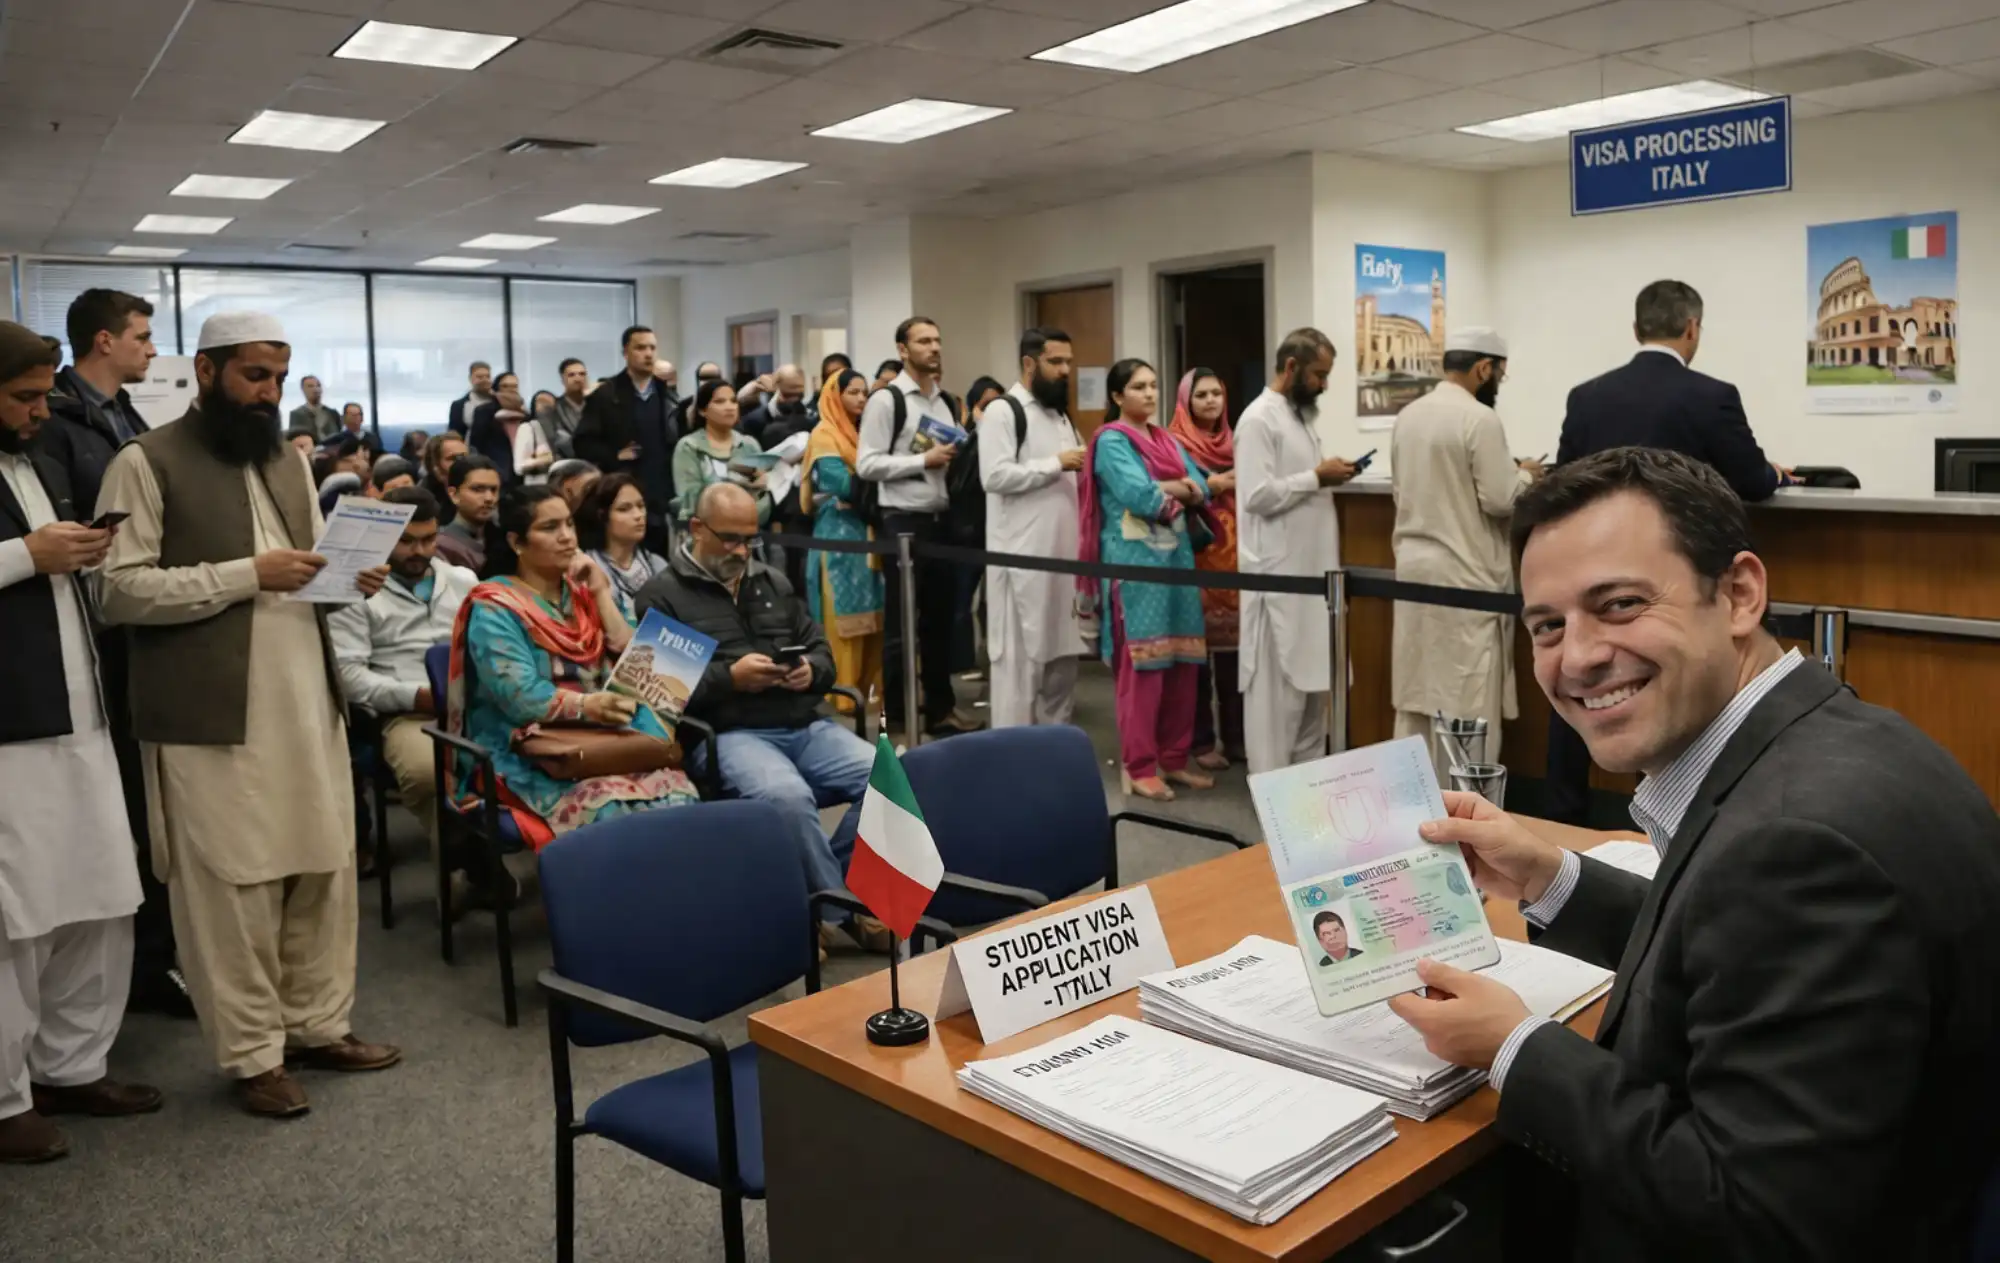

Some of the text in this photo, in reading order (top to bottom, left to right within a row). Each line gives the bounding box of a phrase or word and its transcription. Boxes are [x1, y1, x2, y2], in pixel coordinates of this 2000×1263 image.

[1581, 116, 1776, 167] VISA PROCESSING
[1652, 160, 1710, 191] ITALY
[985, 902, 1134, 968] STUDENT VISA
[1002, 927, 1140, 996] APPLICATION
